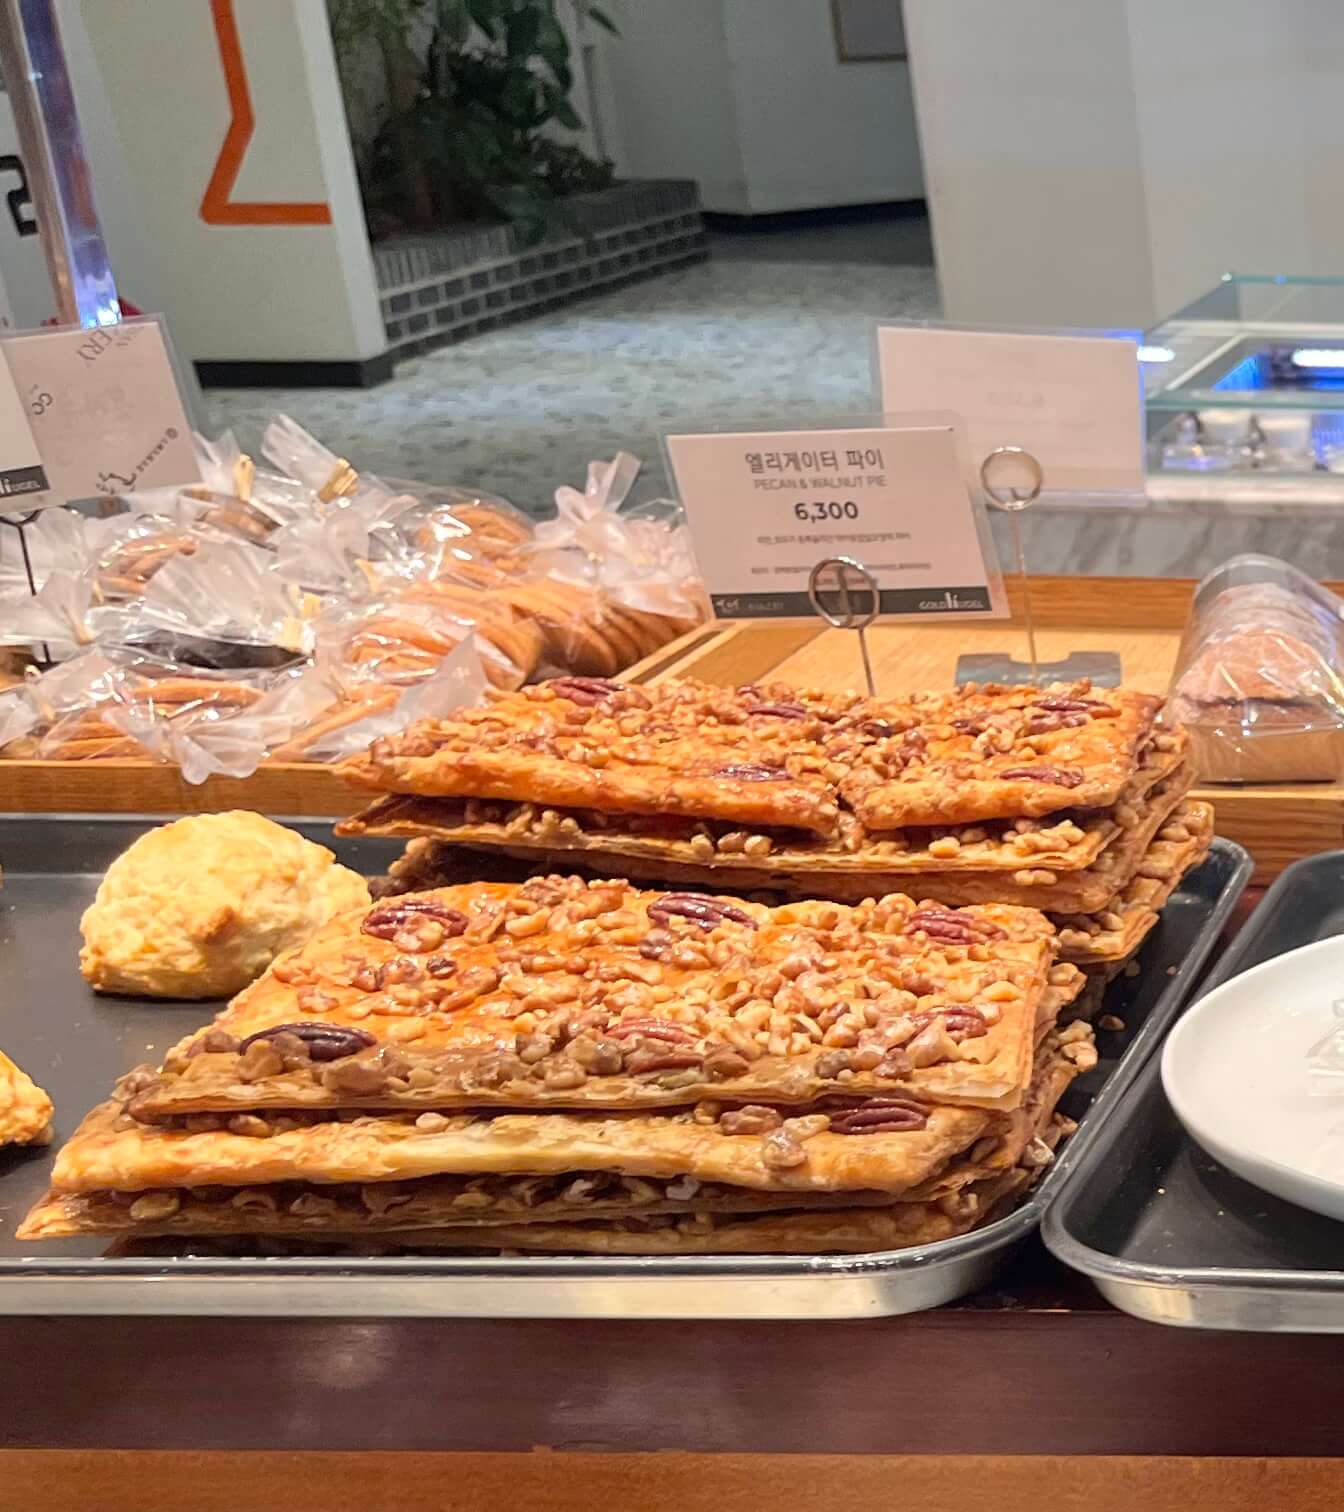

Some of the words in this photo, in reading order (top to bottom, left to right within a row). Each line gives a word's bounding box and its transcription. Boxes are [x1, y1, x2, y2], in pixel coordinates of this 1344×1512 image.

[744, 450, 840, 474] 엘리게이터
[845, 448, 885, 471] 파이
[866, 474, 887, 488] PIE
[794, 501, 859, 523] 6,300
